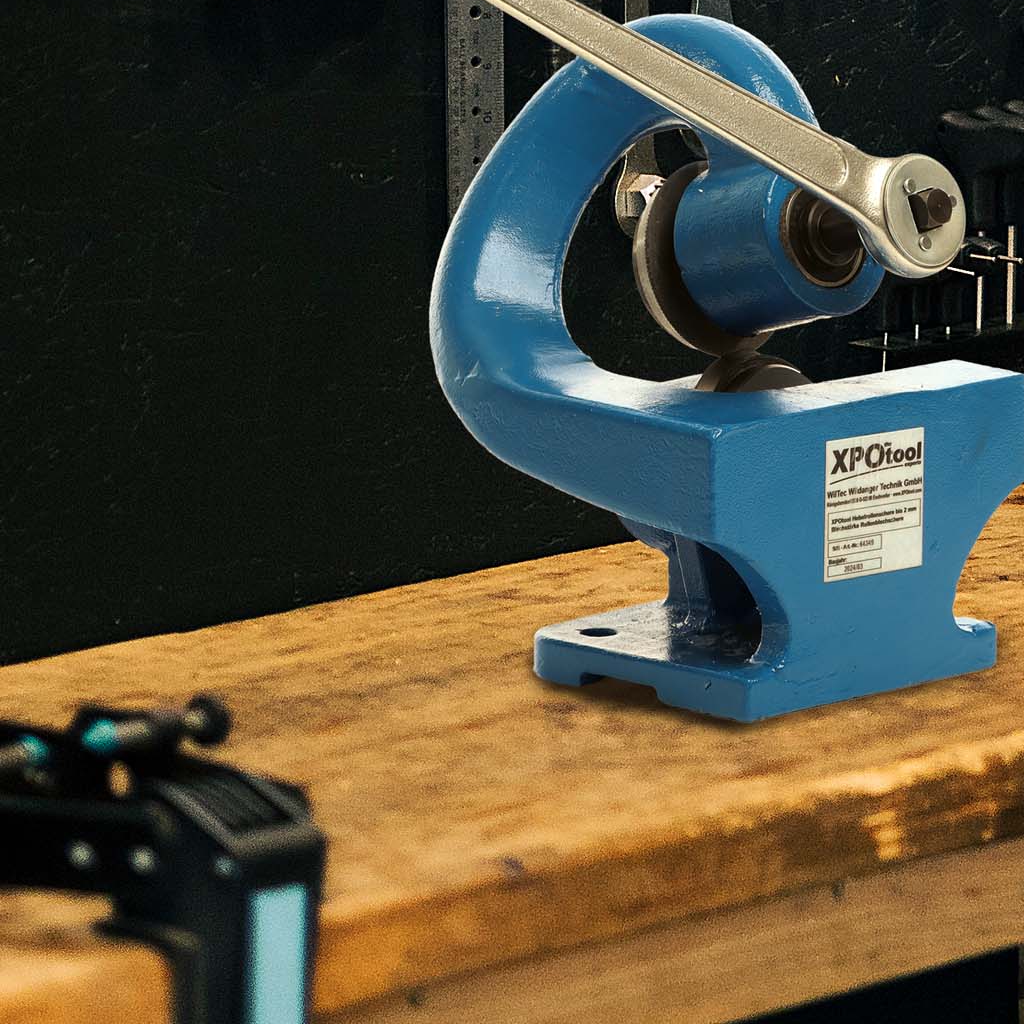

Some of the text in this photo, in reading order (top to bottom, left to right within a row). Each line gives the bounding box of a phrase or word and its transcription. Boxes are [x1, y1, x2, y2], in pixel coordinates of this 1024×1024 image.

[831, 441, 922, 475] XPOtool
[880, 479, 903, 491] Technik
[904, 477, 922, 487] GmbH
